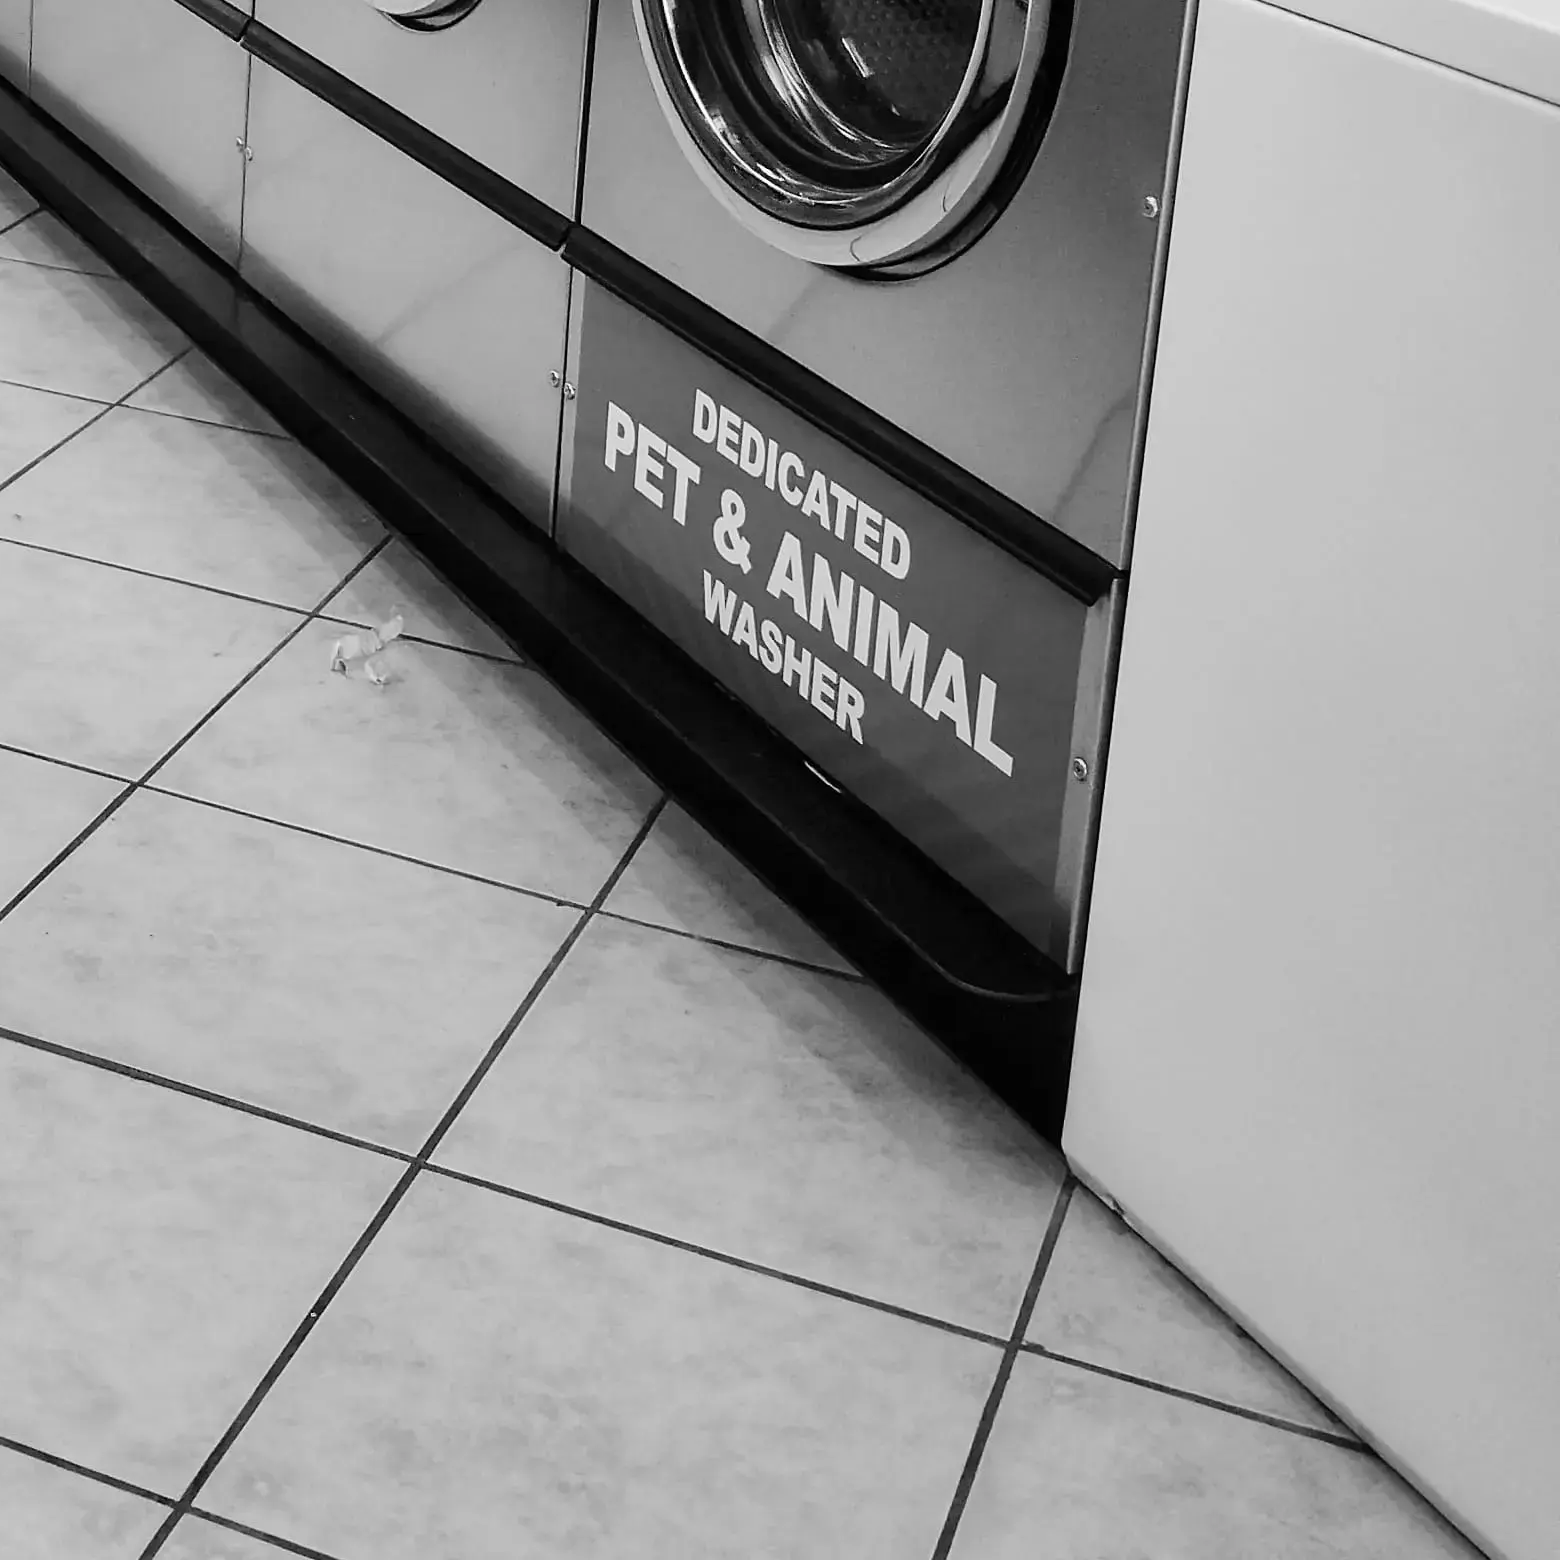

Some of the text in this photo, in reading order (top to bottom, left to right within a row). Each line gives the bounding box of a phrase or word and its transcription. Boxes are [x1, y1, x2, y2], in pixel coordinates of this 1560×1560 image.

[692, 388, 911, 581] DEDICATED
[604, 400, 1014, 778] PET & ANIMAL
[702, 569, 865, 745] WASHER
